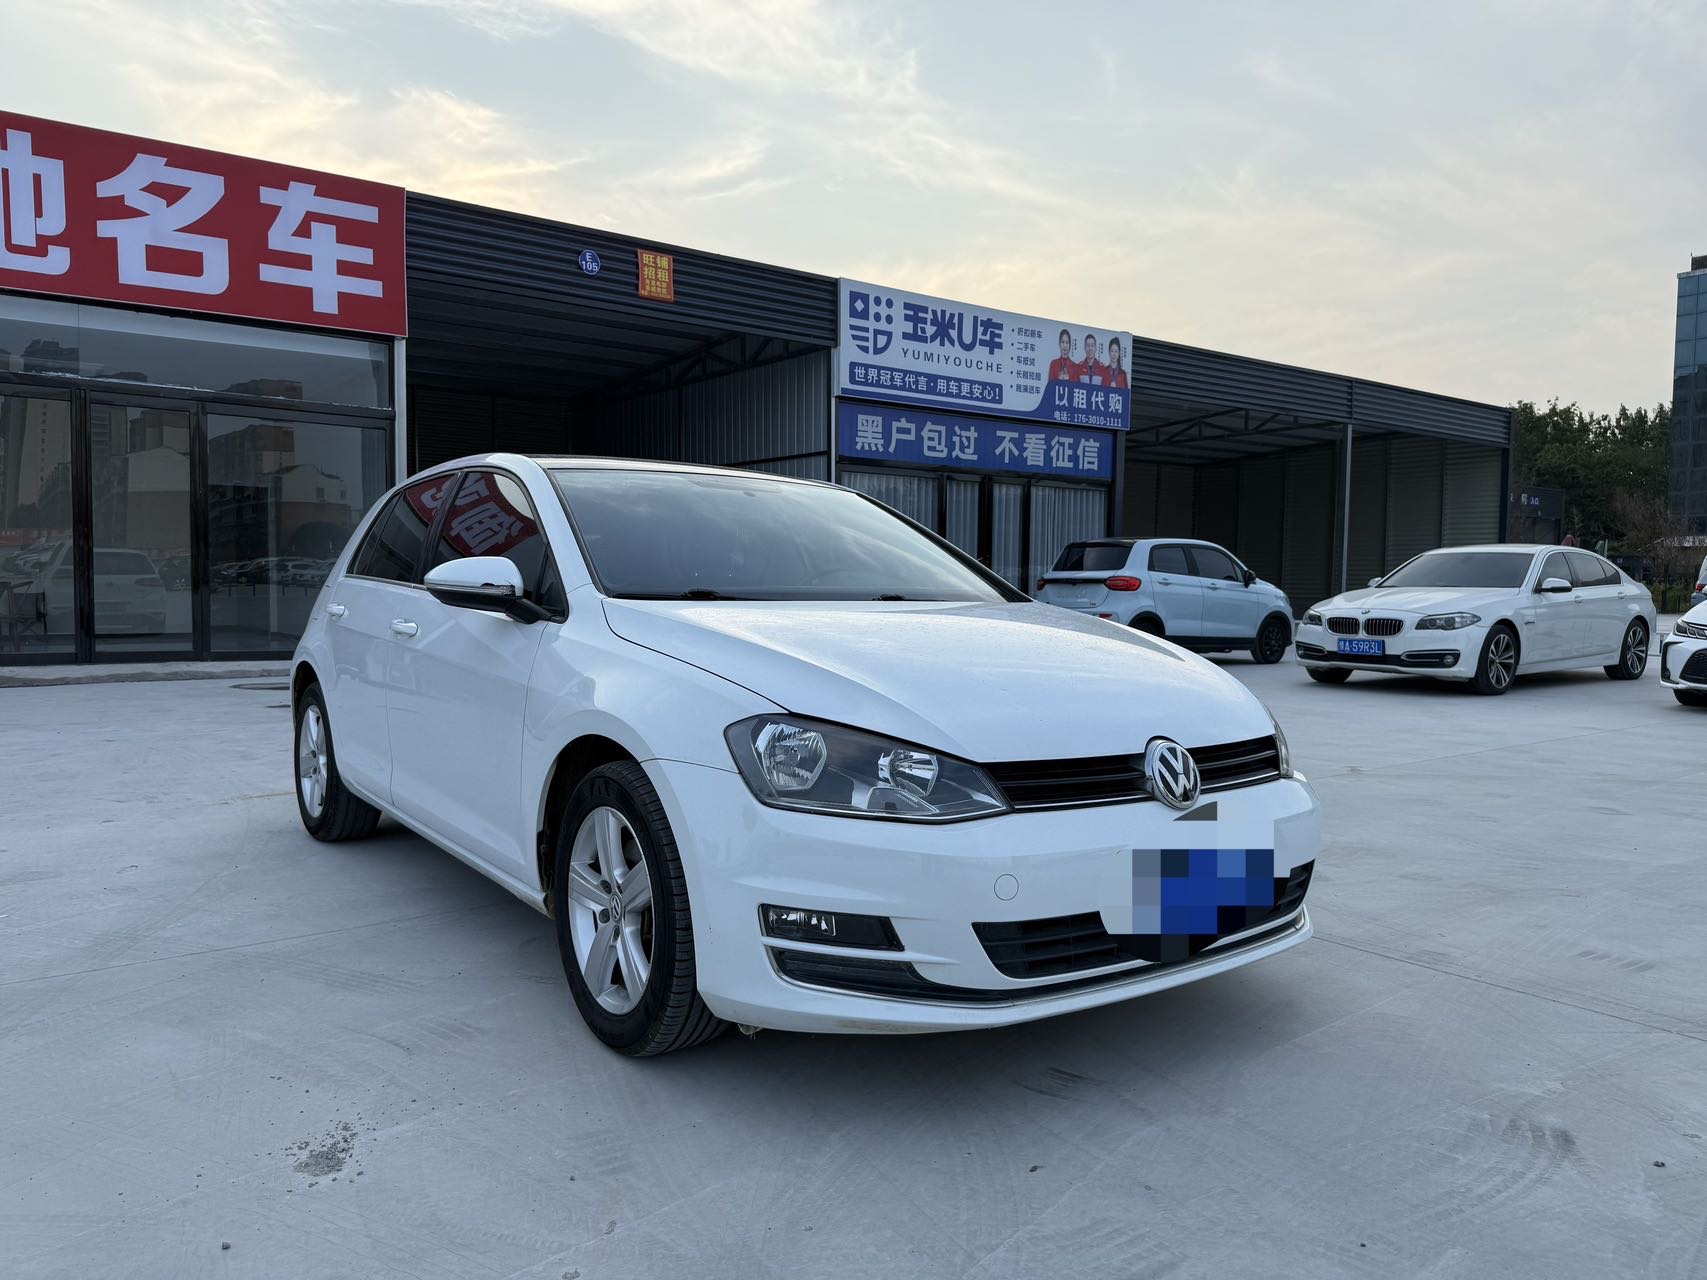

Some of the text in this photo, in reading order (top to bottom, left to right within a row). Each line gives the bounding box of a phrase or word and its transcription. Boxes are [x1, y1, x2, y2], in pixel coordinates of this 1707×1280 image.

[586, 252, 592, 261] E
[643, 253, 669, 269] 旺铺
[581, 261, 598, 271] 105
[643, 266, 669, 282] 招租
[902, 302, 1004, 355] 玉米U车
[1016, 341, 1036, 352] 二手车
[902, 347, 1002, 374] YUMIYOUCHE
[1055, 385, 1123, 414] 以租代购
[855, 413, 1101, 470] 黑户包过 不看征信
